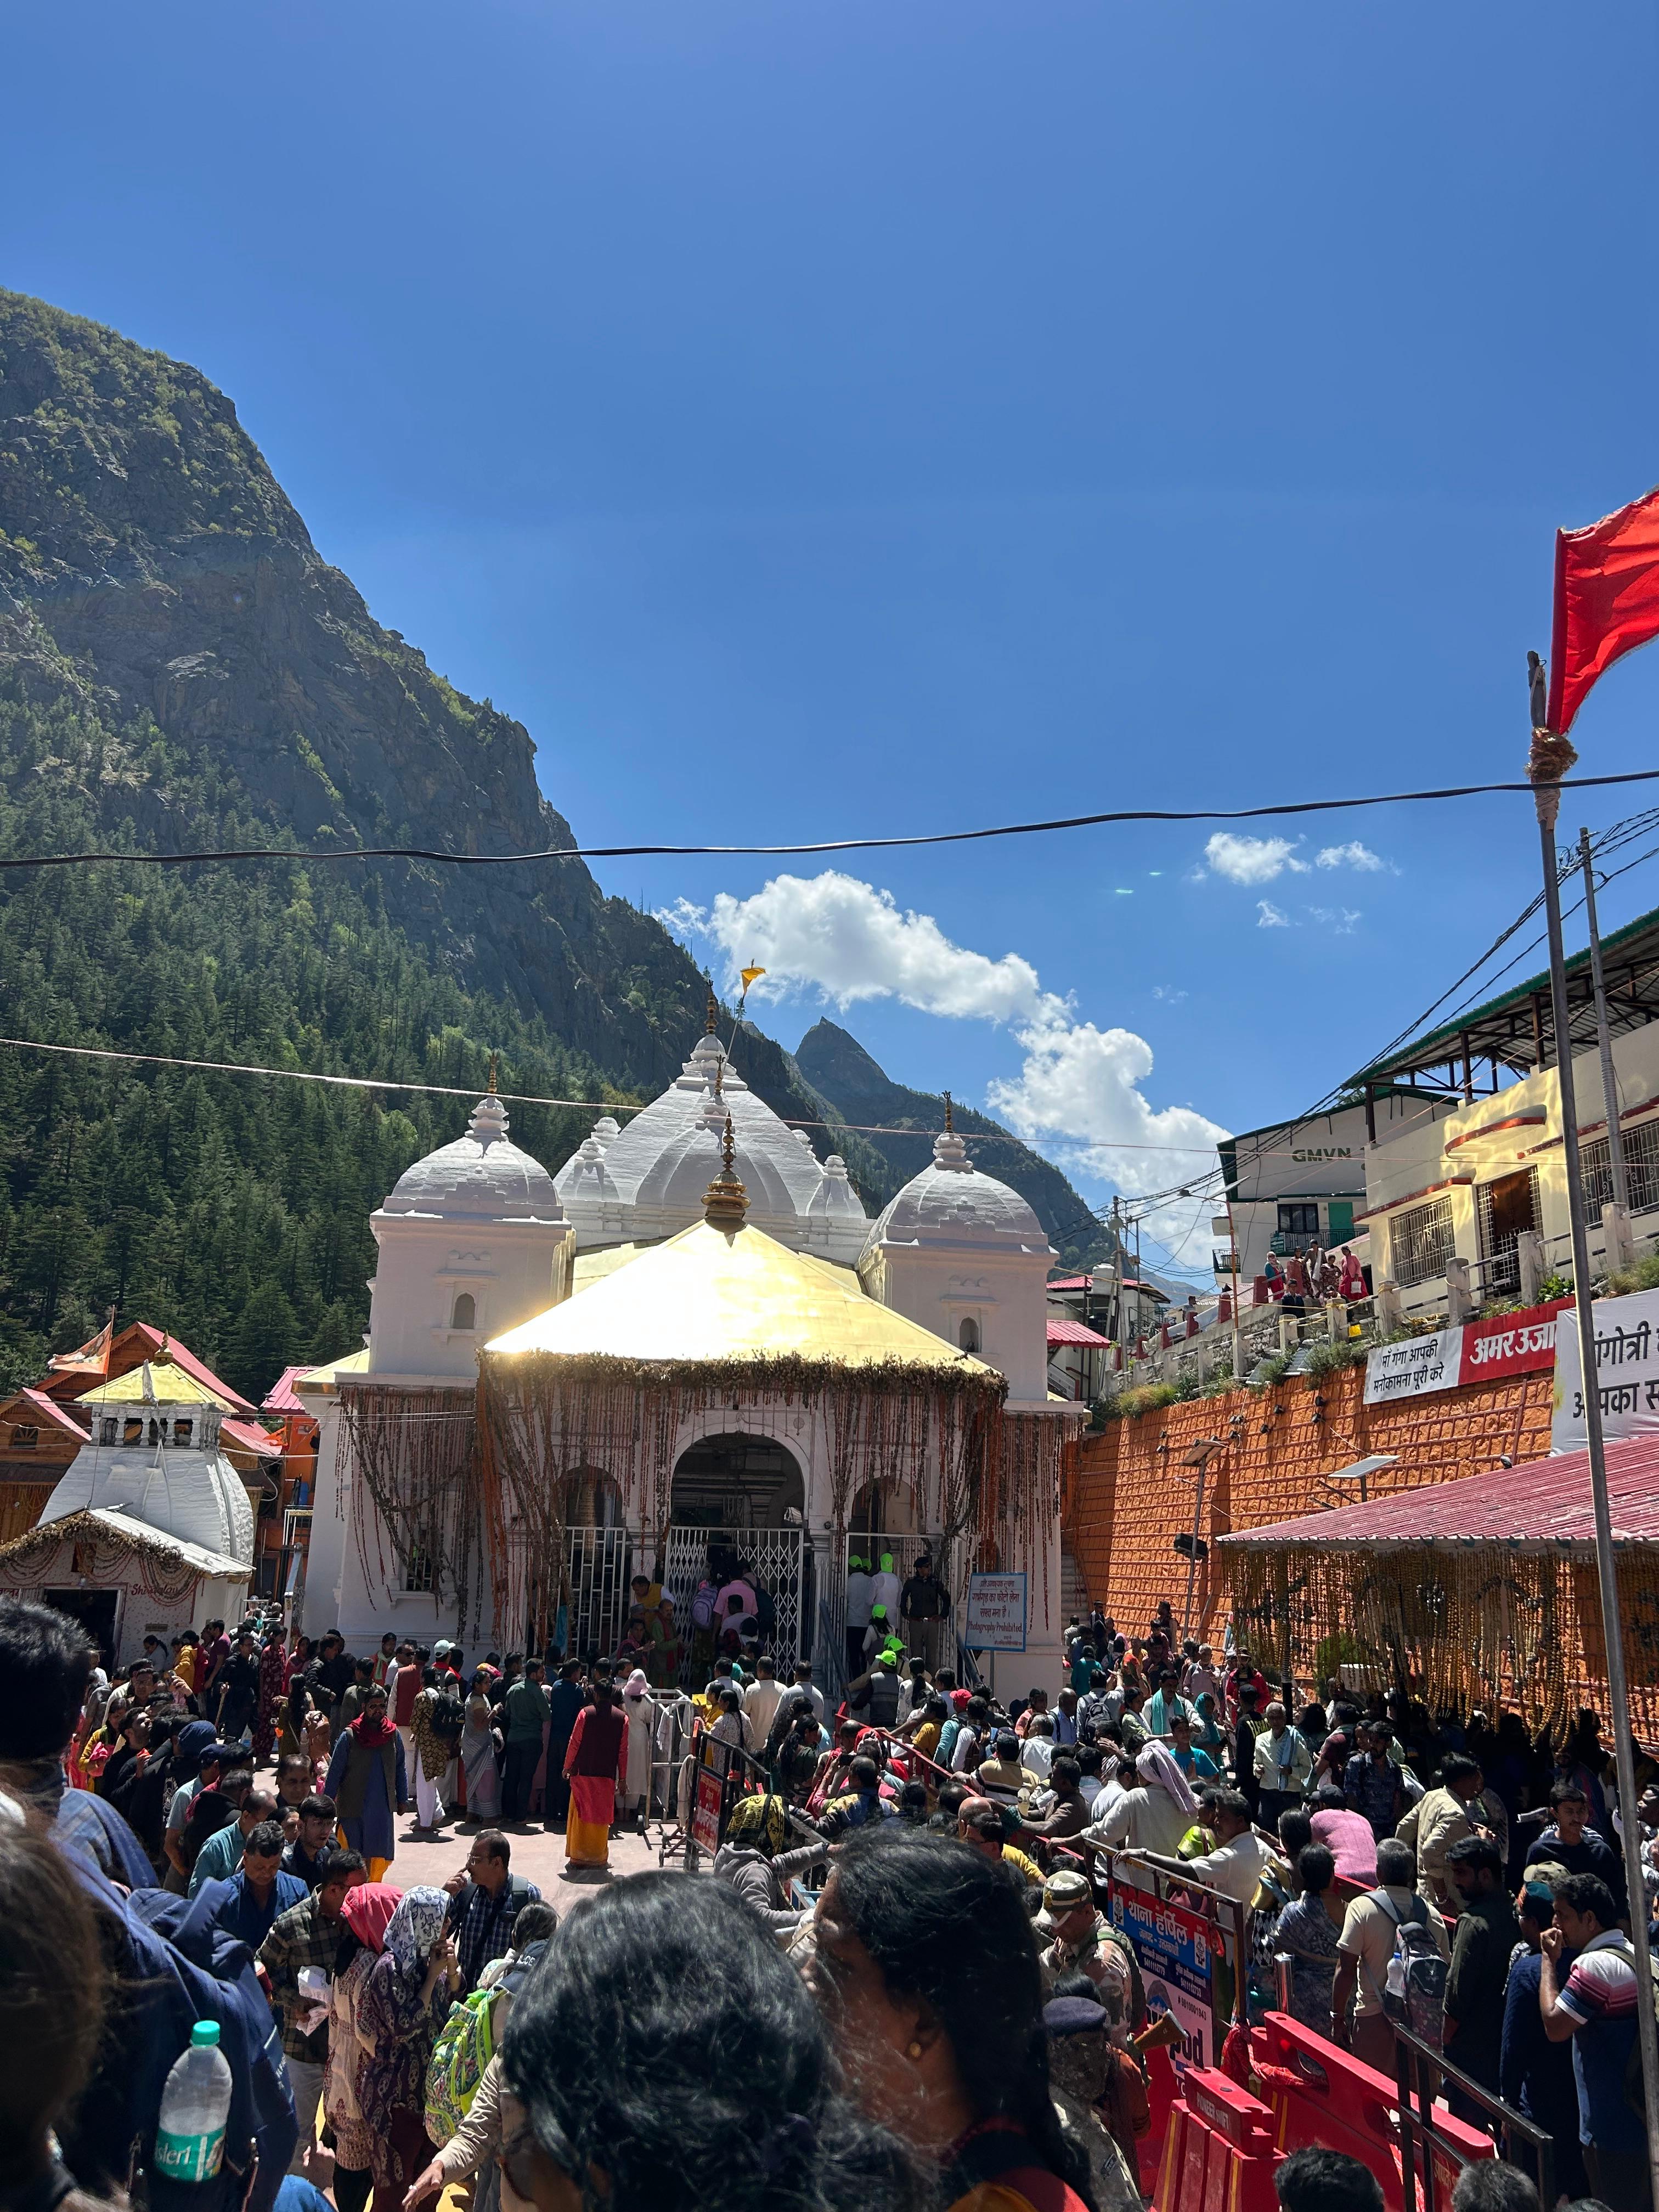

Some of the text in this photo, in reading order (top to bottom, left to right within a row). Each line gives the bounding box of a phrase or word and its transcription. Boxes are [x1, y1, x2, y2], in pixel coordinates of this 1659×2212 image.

[1292, 1148, 1351, 1162] GMVN
[1382, 1339, 1438, 1368] माँ गंगा आपकी
[1470, 1321, 1557, 1364] अमर उजा
[1374, 1361, 1444, 1392] मनोकामना पूरी करे
[972, 1590, 1019, 1606] गर्भगृह का फोटो लेना
[992, 1609, 1001, 1618] मना
[967, 1621, 996, 1634] Photography
[1128, 1899, 1153, 1928] थाना
